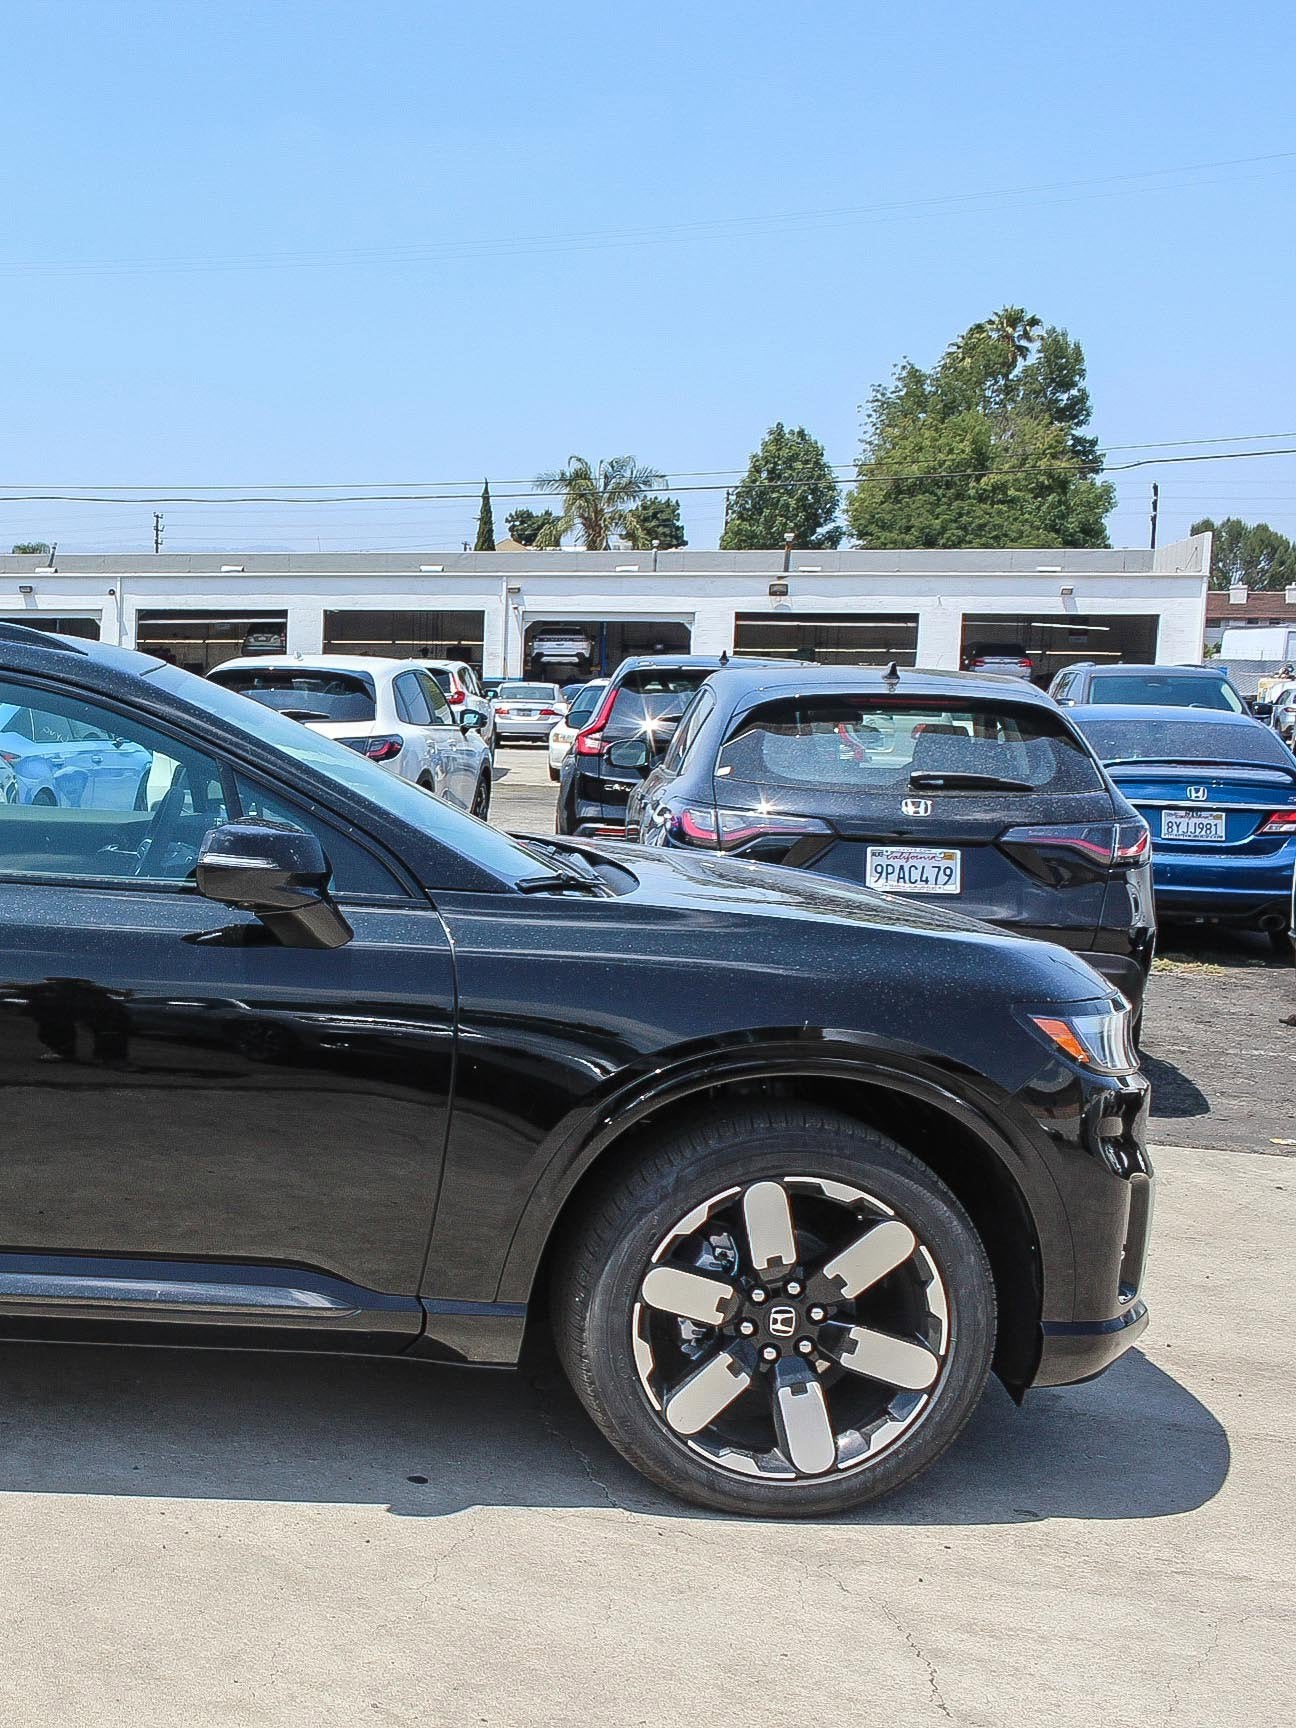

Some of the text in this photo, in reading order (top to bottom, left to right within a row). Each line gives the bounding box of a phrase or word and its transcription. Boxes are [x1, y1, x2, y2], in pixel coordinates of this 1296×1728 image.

[1166, 820, 1218, 835] 8YJJ981
[886, 851, 937, 863] California
[874, 863, 953, 886] 9PAC479
